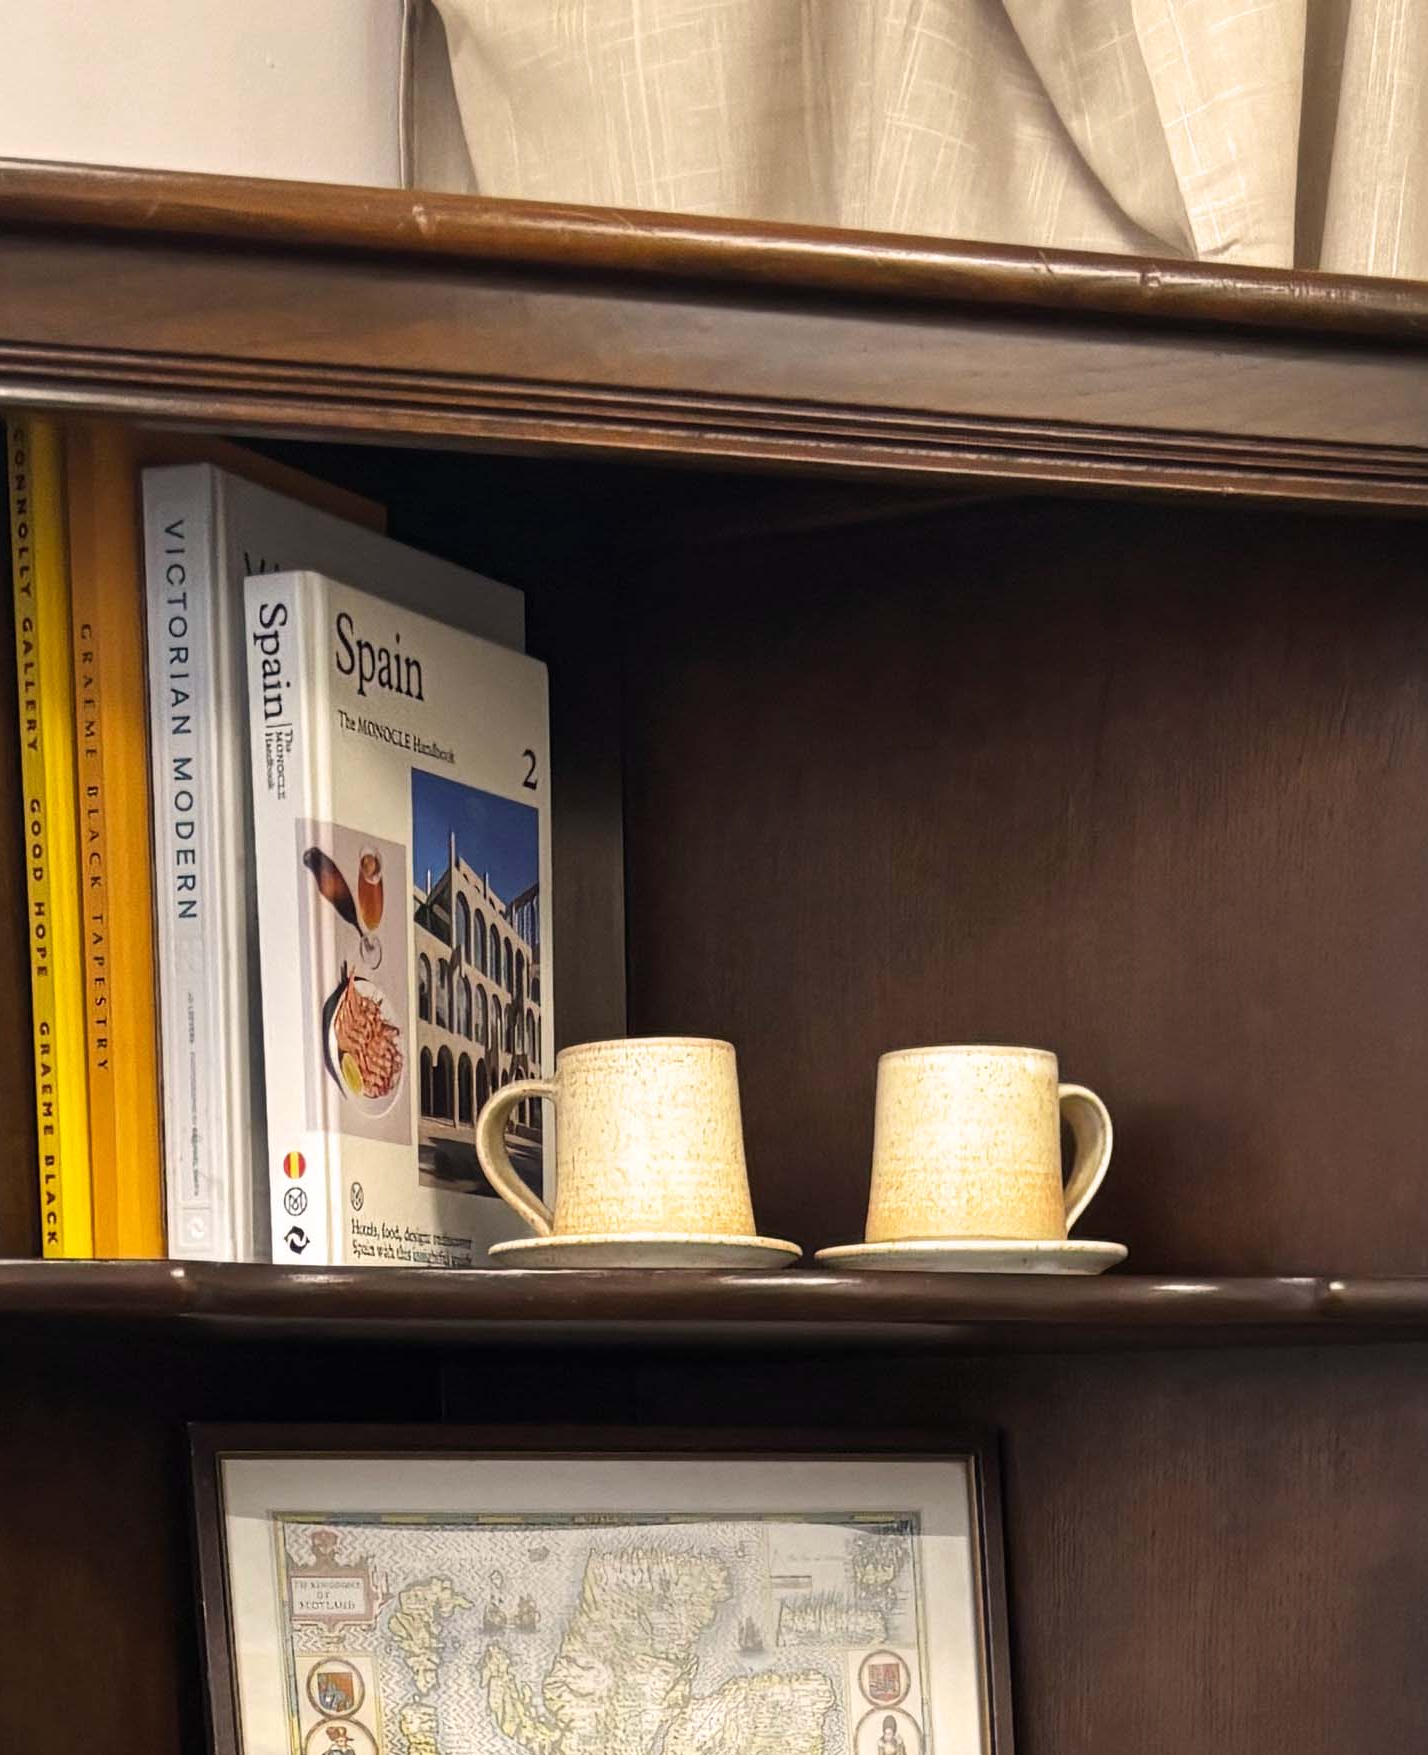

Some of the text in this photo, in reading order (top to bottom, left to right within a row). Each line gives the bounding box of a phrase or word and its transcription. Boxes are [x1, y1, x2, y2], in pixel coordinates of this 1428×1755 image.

[253, 602, 291, 721] Spain
[335, 612, 425, 702] Spain
[164, 519, 198, 920] VICTORIAN MODERN
[275, 731, 286, 800] MONOCLE
[337, 709, 356, 732] The
[357, 716, 411, 751] MONOCLE
[522, 748, 538, 791] 2
[13, 428, 58, 1245] CONNOLLY GALLERY GOOD HOPE GRAEME BLACK
[80, 623, 109, 1071] GRAEME BLACK TAPESTRY
